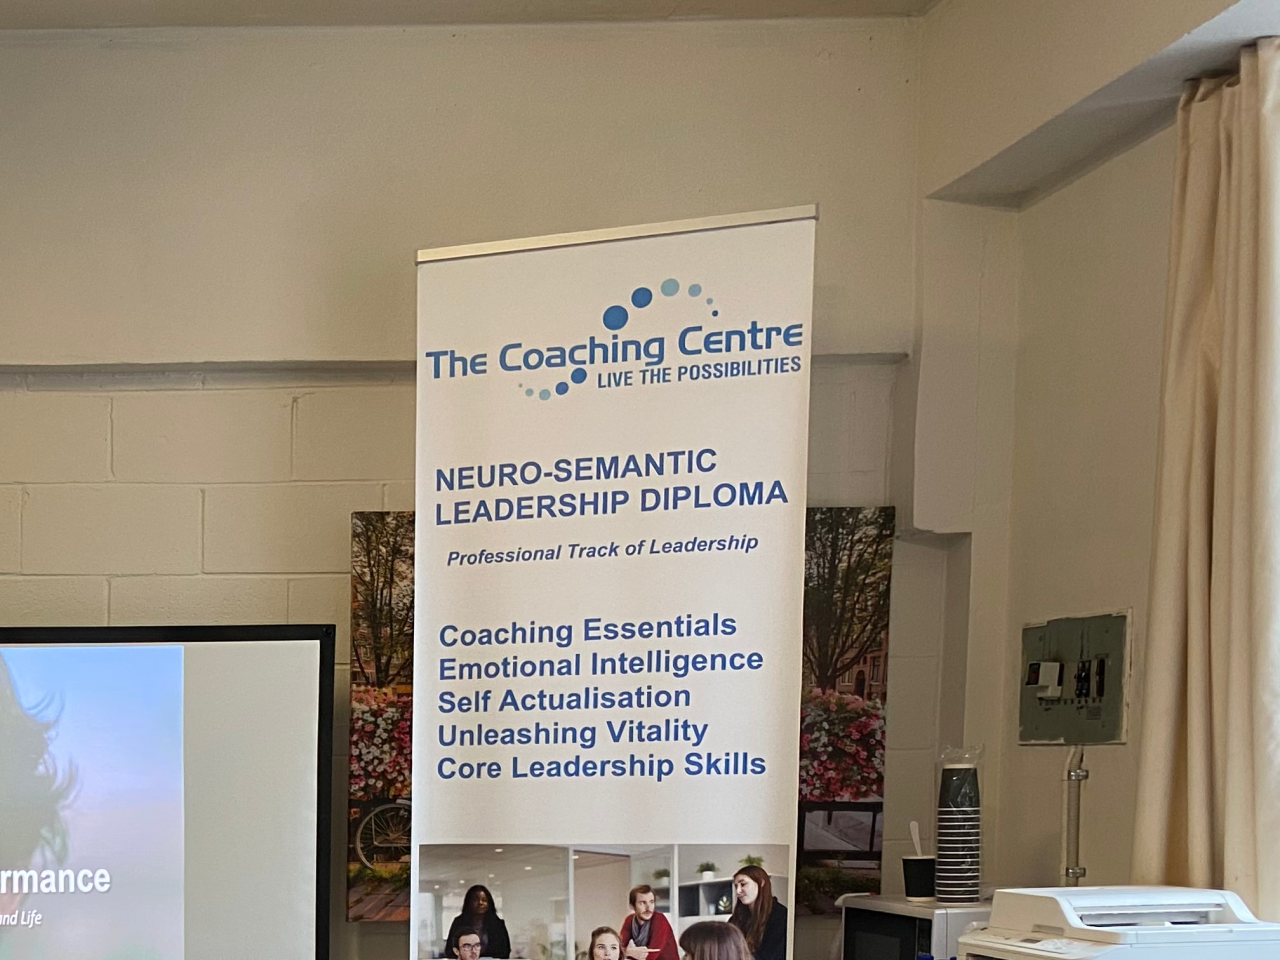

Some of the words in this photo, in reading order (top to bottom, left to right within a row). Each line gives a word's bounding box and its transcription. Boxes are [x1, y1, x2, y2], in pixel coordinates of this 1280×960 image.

[425, 349, 488, 379] The
[499, 333, 665, 371] Coaching
[678, 320, 803, 355] Centre
[597, 370, 633, 389] LIVE
[639, 367, 672, 385] THE
[677, 356, 802, 382] POSSIBILITIES
[435, 448, 717, 491] NEURO-SEMANTIC
[435, 489, 630, 526] LEADERSHIP
[640, 480, 789, 512] DIPLOMA
[447, 544, 562, 567] Professional
[568, 541, 620, 559] Track
[625, 538, 644, 556] of
[649, 534, 759, 555] Leadership
[439, 621, 573, 647] Coaching
[583, 612, 737, 642] Essentials
[439, 653, 581, 680] Emotional
[591, 649, 764, 678] Intelligence
[438, 690, 491, 714] Self
[498, 686, 691, 712] Actualisation
[438, 721, 597, 749] Unleashing
[606, 718, 708, 746] Vitality
[437, 757, 502, 780] Core
[511, 754, 674, 782] Leadership
[683, 751, 767, 776] Skills
[19, 910, 43, 928] Life
